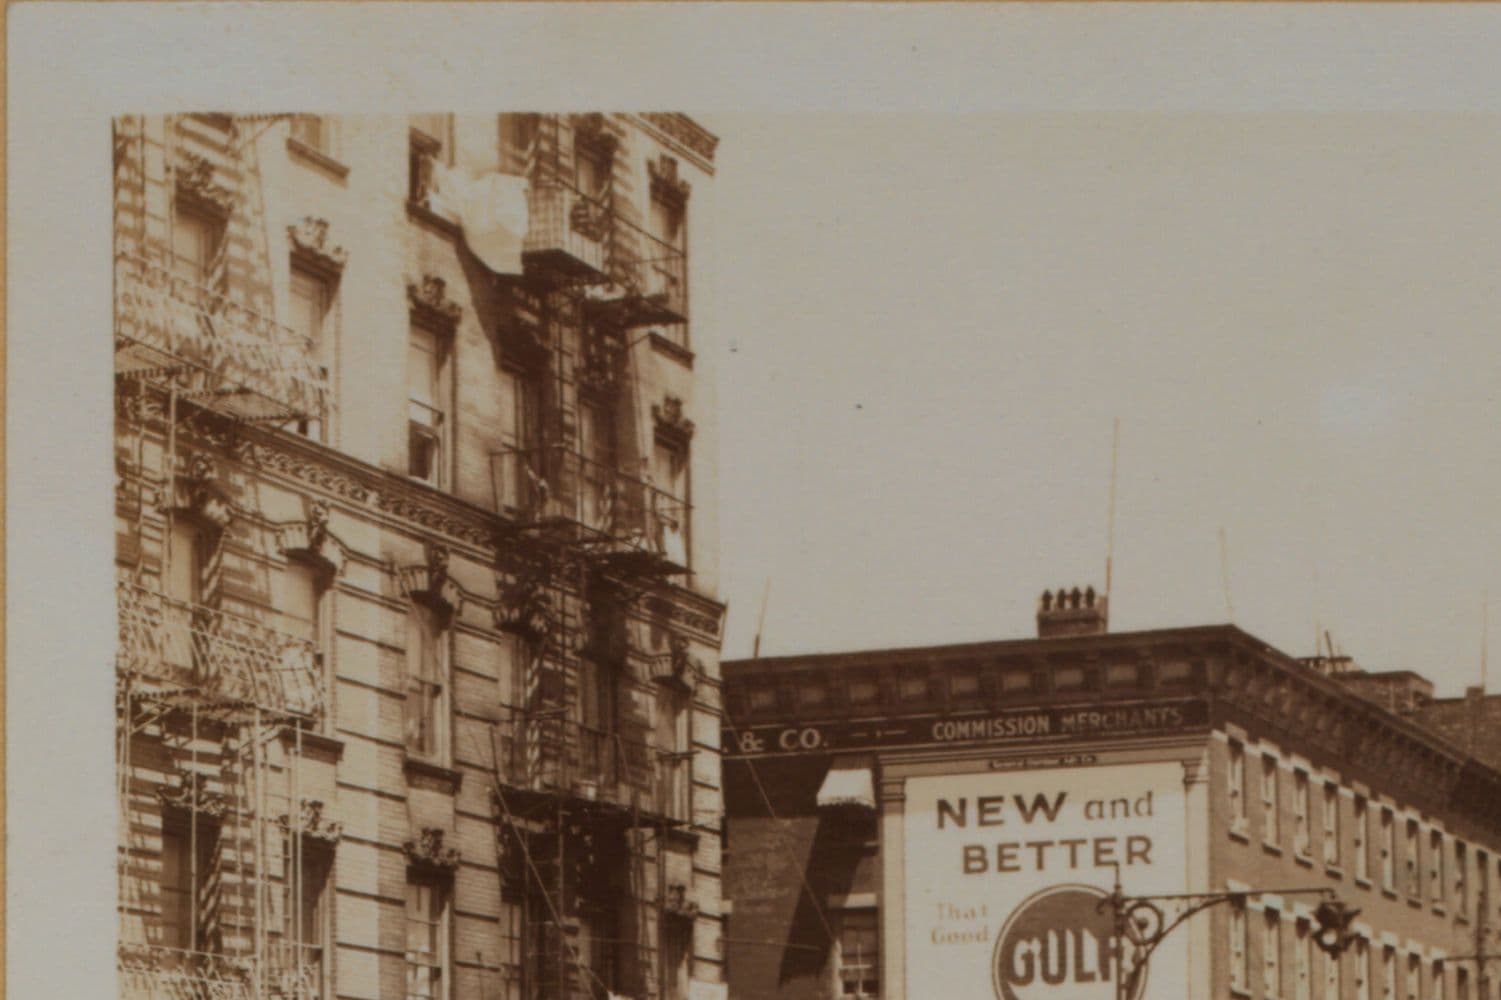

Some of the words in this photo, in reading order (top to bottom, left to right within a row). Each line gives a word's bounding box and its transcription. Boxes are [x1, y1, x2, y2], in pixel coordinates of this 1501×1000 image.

[931, 714, 1050, 741] COMMISSION
[1060, 706, 1185, 733] MERCHANTS
[739, 731, 765, 752] &
[779, 727, 829, 750] CO.
[935, 791, 1068, 830] NEW
[1083, 790, 1154, 821] and
[962, 835, 1154, 875] BETTER
[935, 902, 989, 922] That
[930, 925, 989, 946] Good
